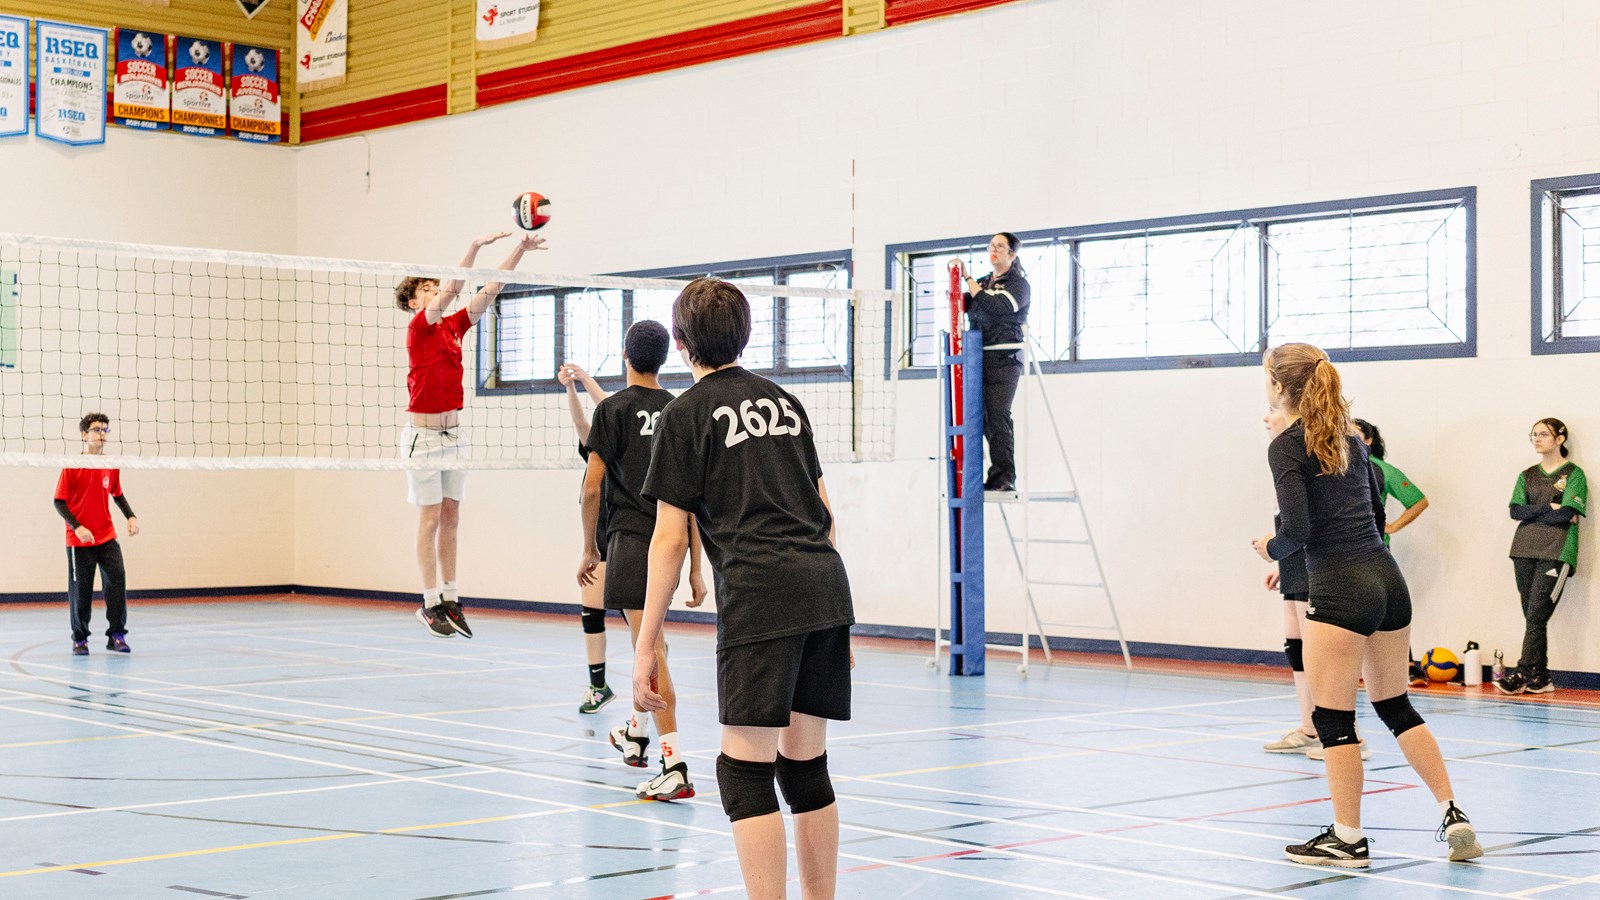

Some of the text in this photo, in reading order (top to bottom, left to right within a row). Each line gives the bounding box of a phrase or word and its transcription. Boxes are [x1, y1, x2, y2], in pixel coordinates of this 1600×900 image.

[46, 37, 99, 59] RSEQ
[45, 56, 97, 69] BASKETBALL
[127, 61, 156, 78] SOCCER
[50, 77, 93, 91] CHAMPIONS
[185, 68, 213, 84] SOCCER
[240, 76, 268, 91] SOCCER
[58, 109, 86, 121] RSEQ
[118, 104, 165, 120] CHAMPIONS
[173, 111, 224, 127] CHAMPIONNES
[232, 118, 276, 133] CHAMPIONS
[712, 398, 802, 449] 2625
